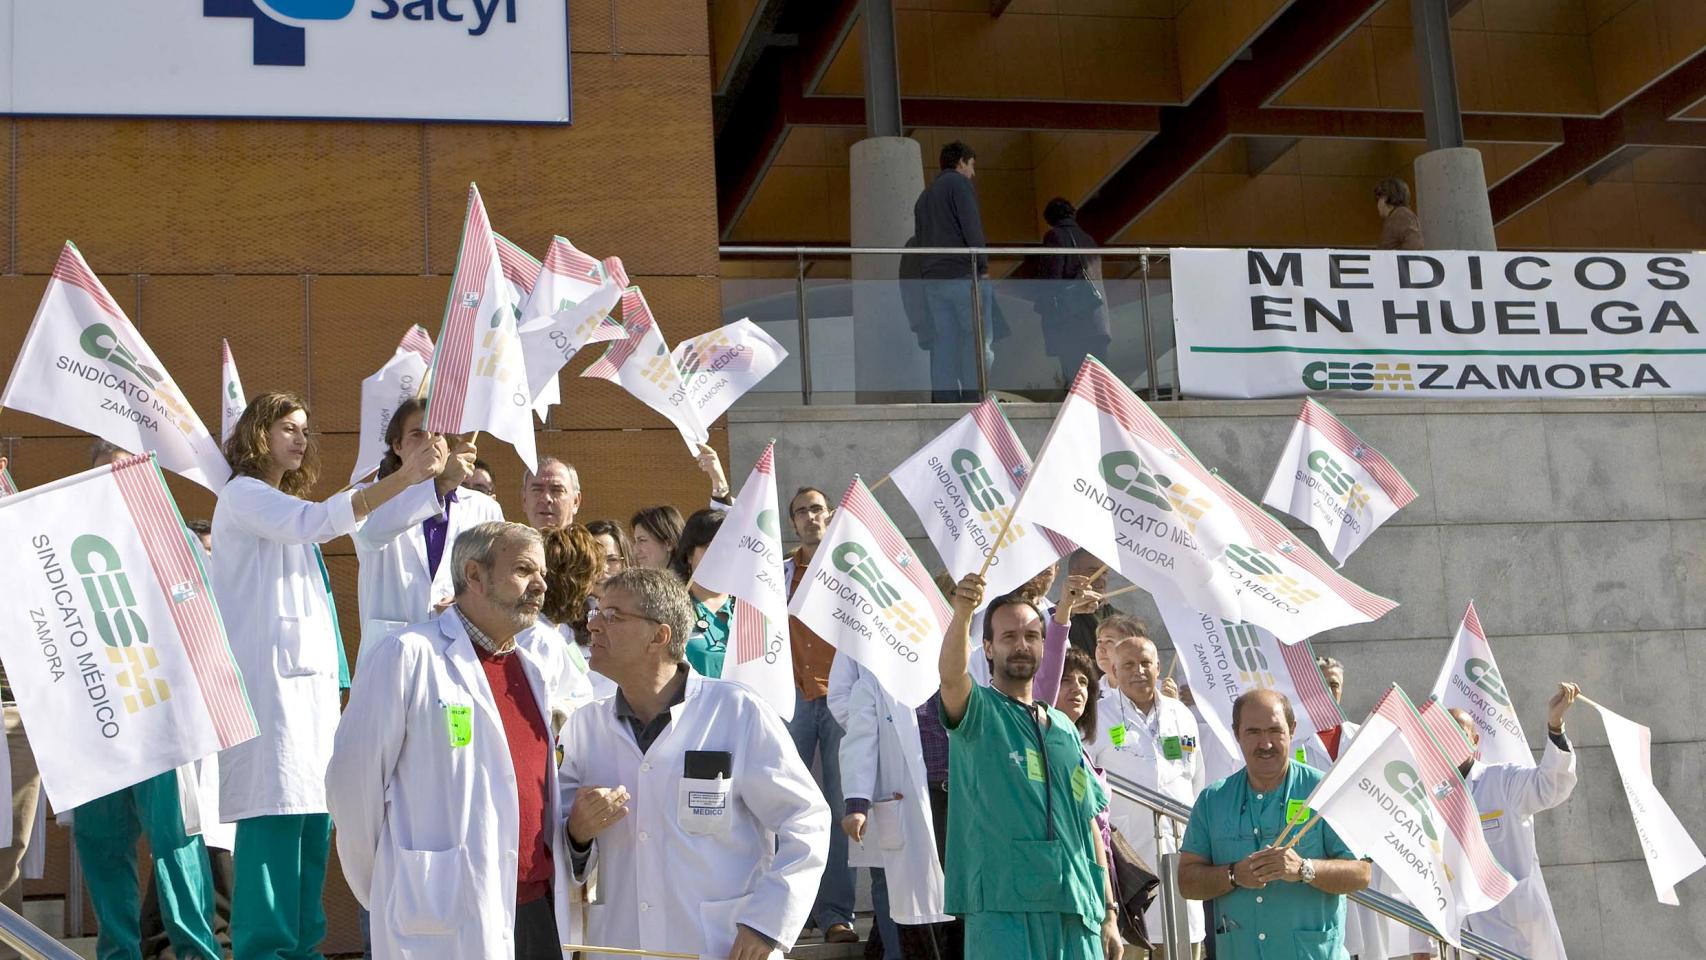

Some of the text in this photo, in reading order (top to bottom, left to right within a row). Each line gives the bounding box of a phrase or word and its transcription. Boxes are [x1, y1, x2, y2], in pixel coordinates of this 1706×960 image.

[1247, 250, 1691, 291] MEDICOS
[1250, 295, 1700, 335] EN HUELGA
[56, 355, 149, 403] SINDICATO
[1302, 361, 1672, 391] CESM ZAMORA
[100, 398, 158, 432] ZAMORA
[928, 456, 999, 566] SINDICATO MÉDICO
[934, 498, 961, 541] ZAMORA
[1073, 478, 1168, 538] SINDICATO
[1115, 532, 1175, 570] ZAMORA
[815, 568, 919, 662] INDICATO MÉDICO
[1242, 580, 1300, 614] MÉDICO
[30, 607, 66, 683] ZAMORA
[32, 534, 119, 739] SINDICATO MÉDICO
[70, 534, 172, 714] CESM
[832, 607, 873, 640] ZAMORA
[1193, 643, 1216, 690] ZAMORA
[1452, 674, 1496, 716] SINDICATO
[1384, 831, 1429, 880] ZAMORA
